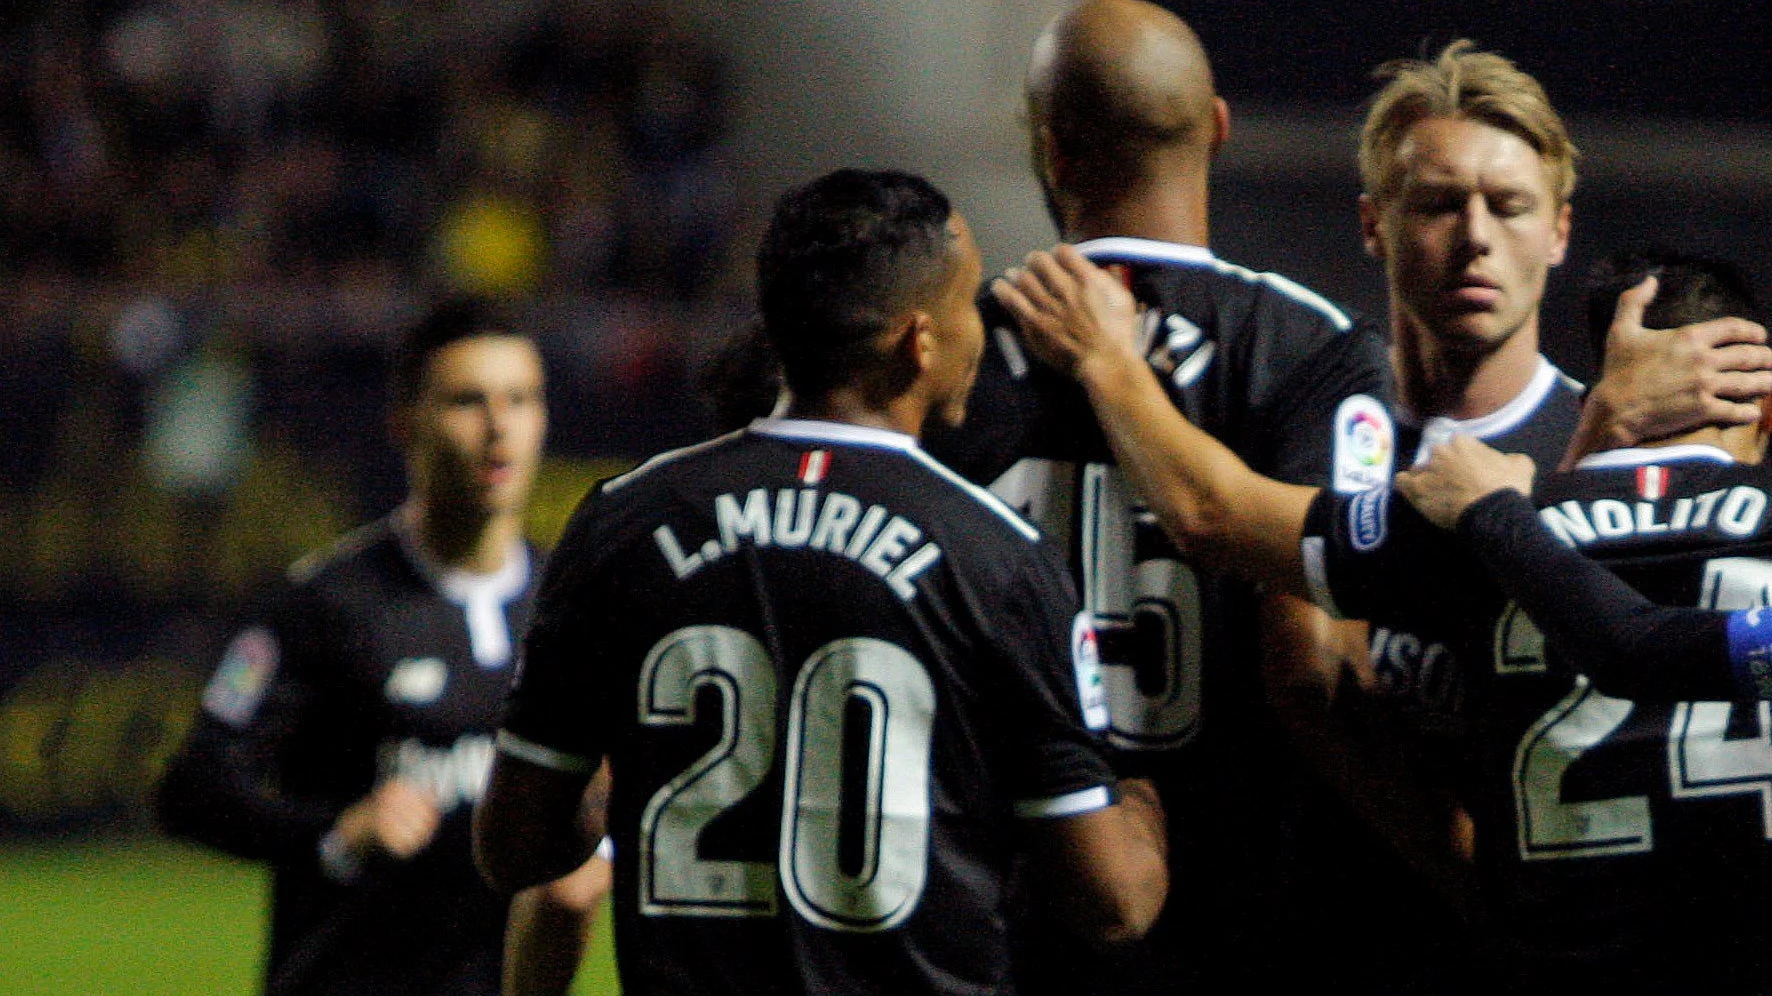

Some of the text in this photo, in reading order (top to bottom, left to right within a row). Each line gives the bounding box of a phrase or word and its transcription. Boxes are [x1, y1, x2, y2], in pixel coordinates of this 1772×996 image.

[652, 488, 942, 601] L.MURIEL
[1538, 484, 1768, 549] NOLITO
[637, 624, 938, 934] 20
